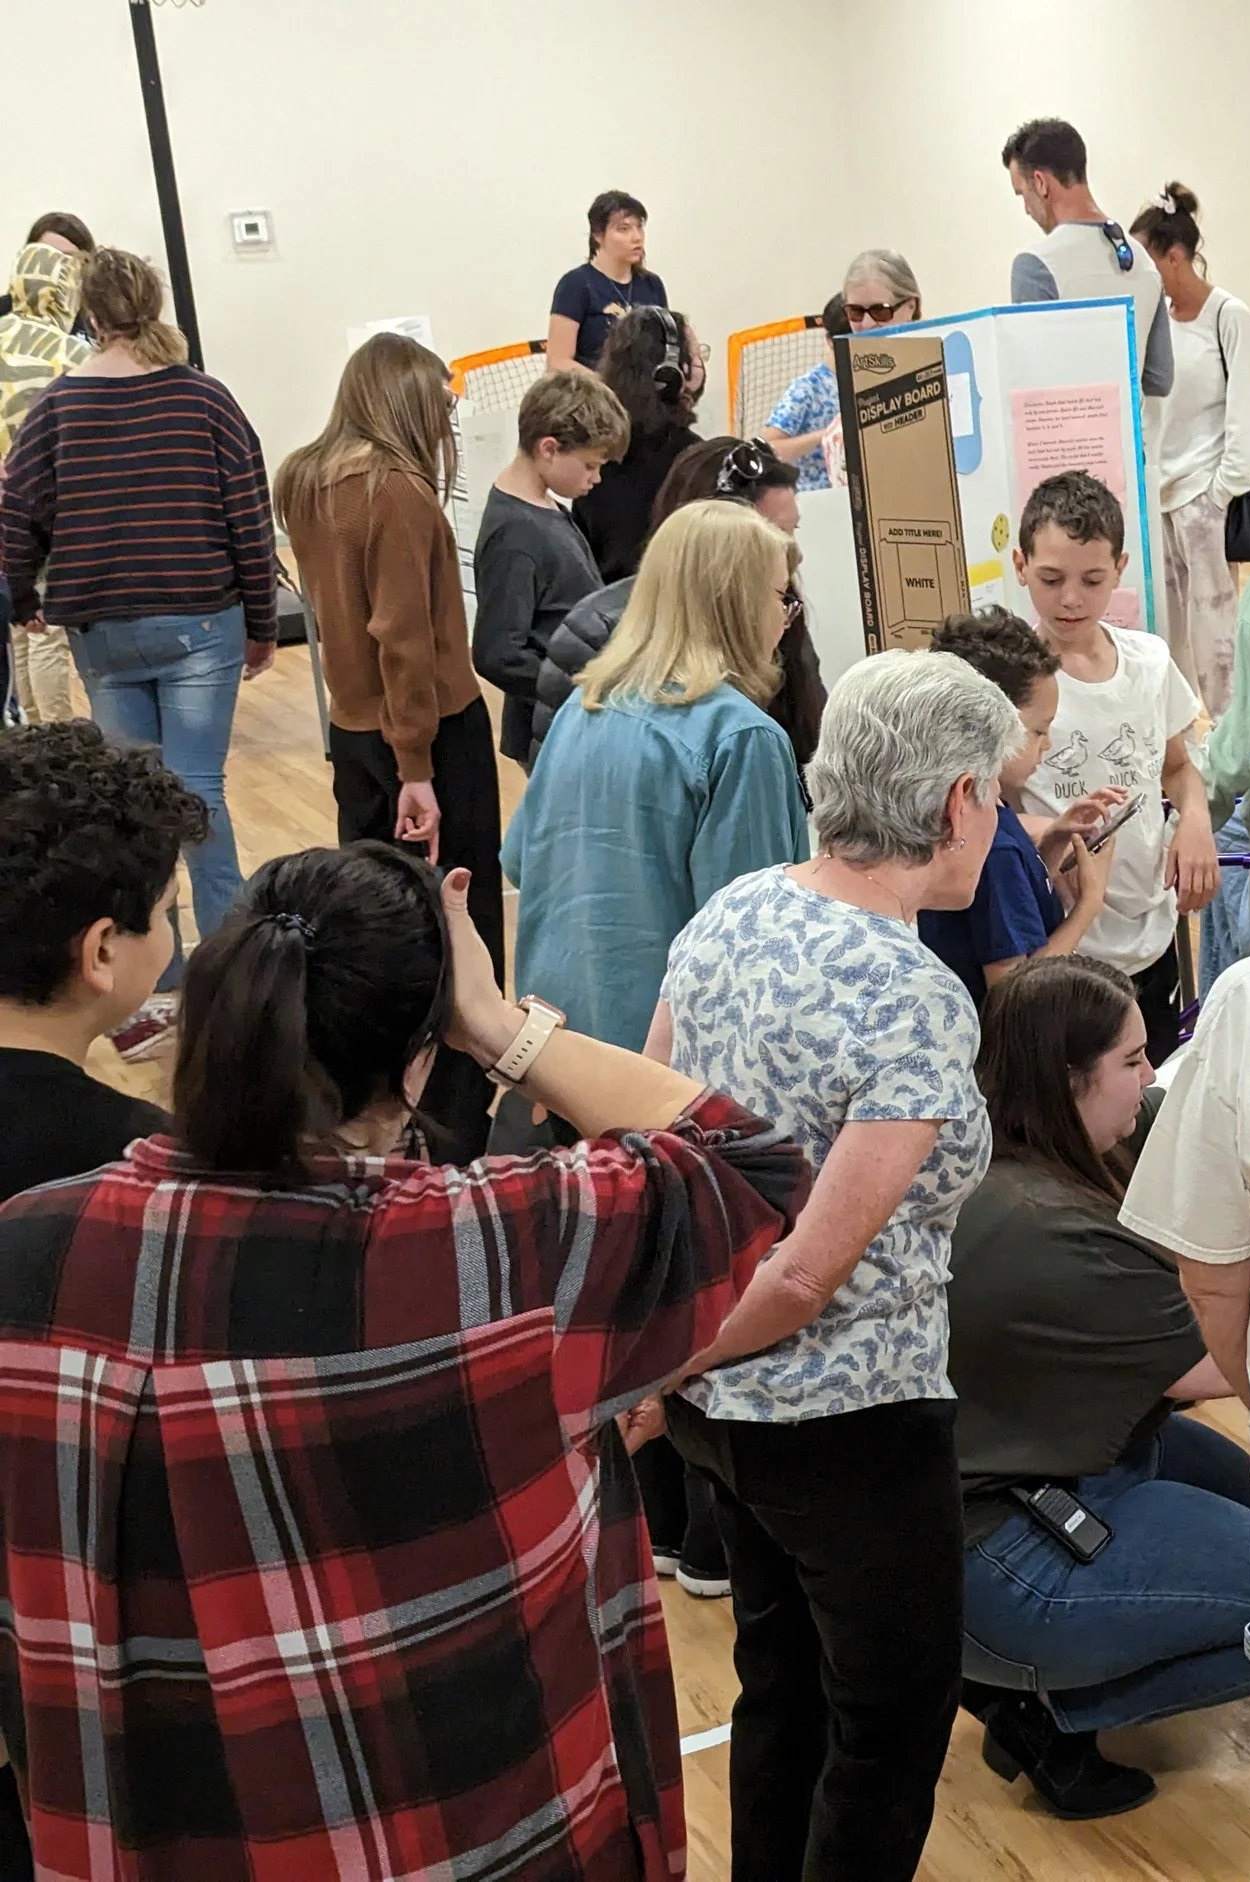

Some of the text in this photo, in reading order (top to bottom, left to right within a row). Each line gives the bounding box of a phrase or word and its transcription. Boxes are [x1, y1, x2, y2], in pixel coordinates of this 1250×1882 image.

[853, 353, 896, 373] ArtSkills
[860, 381, 941, 423] DISPLAY BOARD
[894, 408, 923, 427] HEADER
[888, 527, 903, 536] ADD
[905, 528, 921, 537] TITLE
[905, 577, 935, 589] WHITE
[1109, 770, 1139, 788] DUCK
[1054, 779, 1089, 799] DUCK
